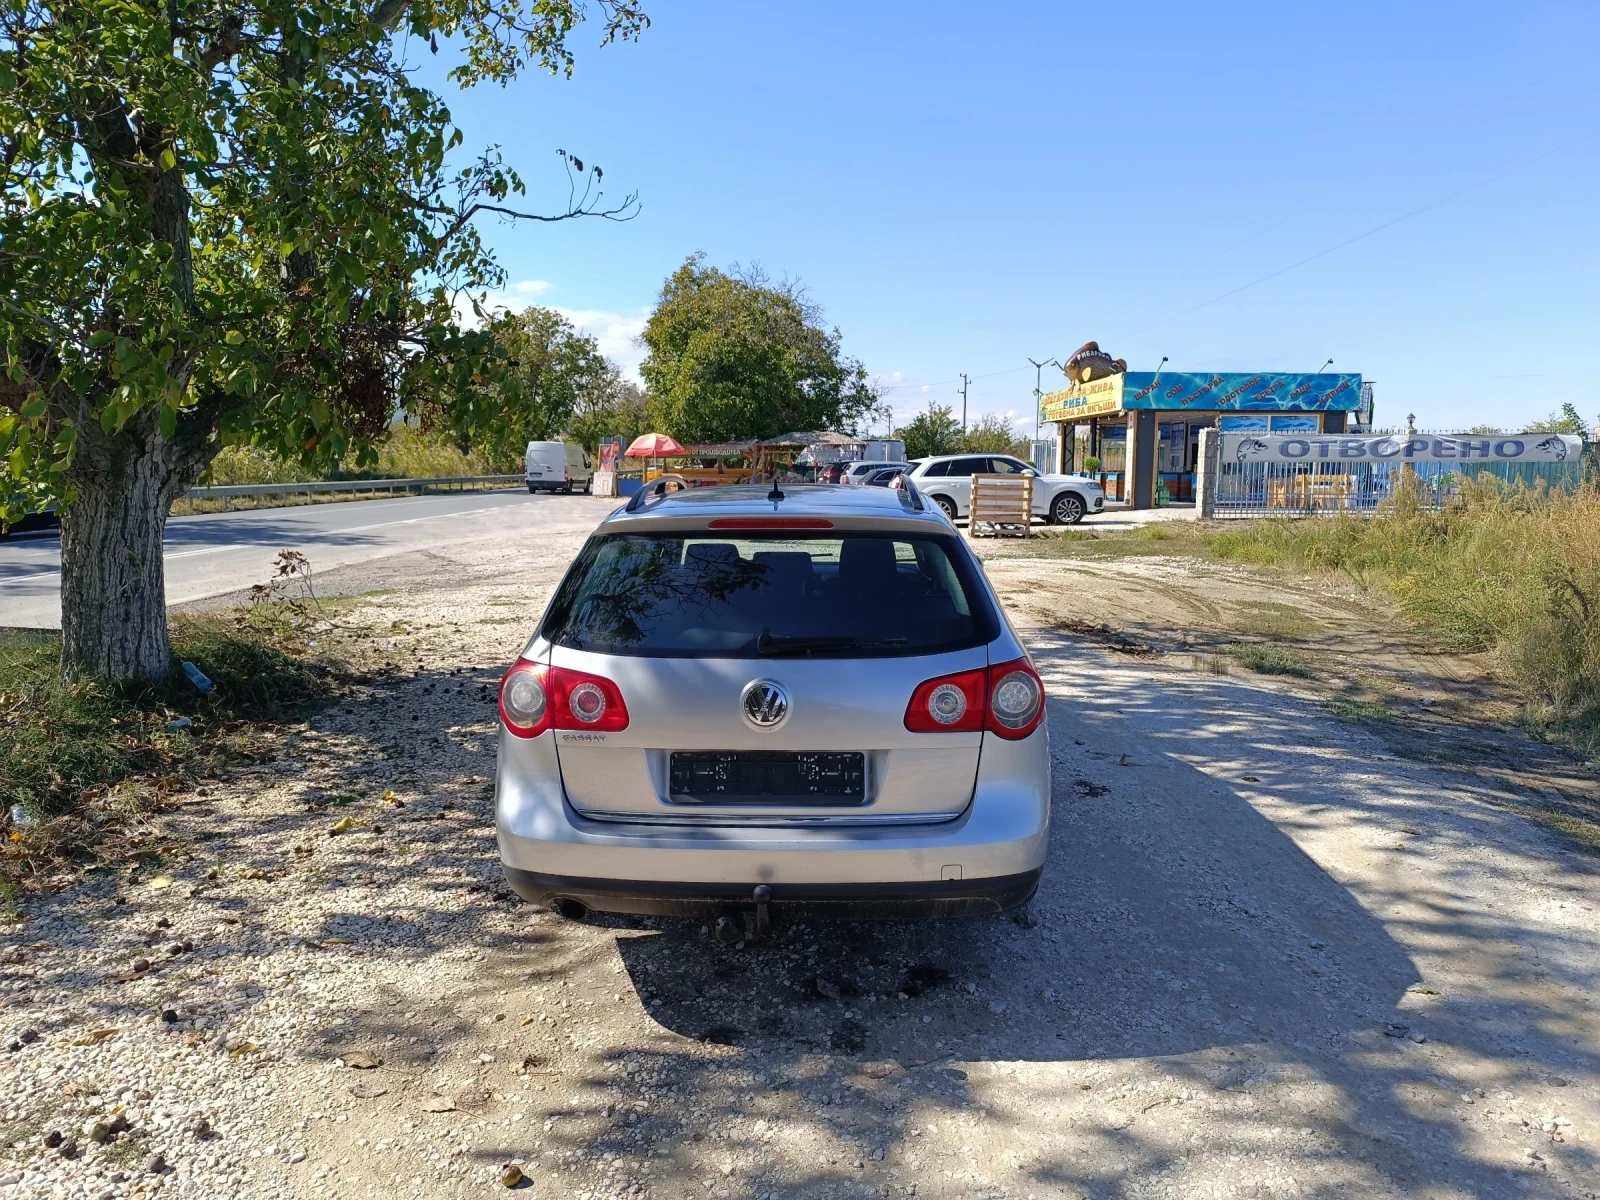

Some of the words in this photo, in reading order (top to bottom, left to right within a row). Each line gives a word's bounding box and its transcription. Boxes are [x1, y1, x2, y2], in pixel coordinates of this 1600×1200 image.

[1090, 381, 1114, 394] ЖИВА
[1134, 380, 1162, 401] ШАРАН
[1165, 383, 1184, 399] СОМ
[1181, 377, 1225, 406] ПЪСТЪРВА
[1255, 379, 1286, 402] ЕСЕТРА
[1289, 381, 1312, 399] РАЦИ
[1048, 408, 1075, 420] ГОТВЕНА
[1076, 407, 1085, 416] ЗА
[1087, 401, 1116, 414] ВКЪЩИ
[1063, 395, 1088, 409] РИБА
[1279, 438, 1525, 459] ОТВОРЕНО
[562, 734, 606, 743] PASSAT
